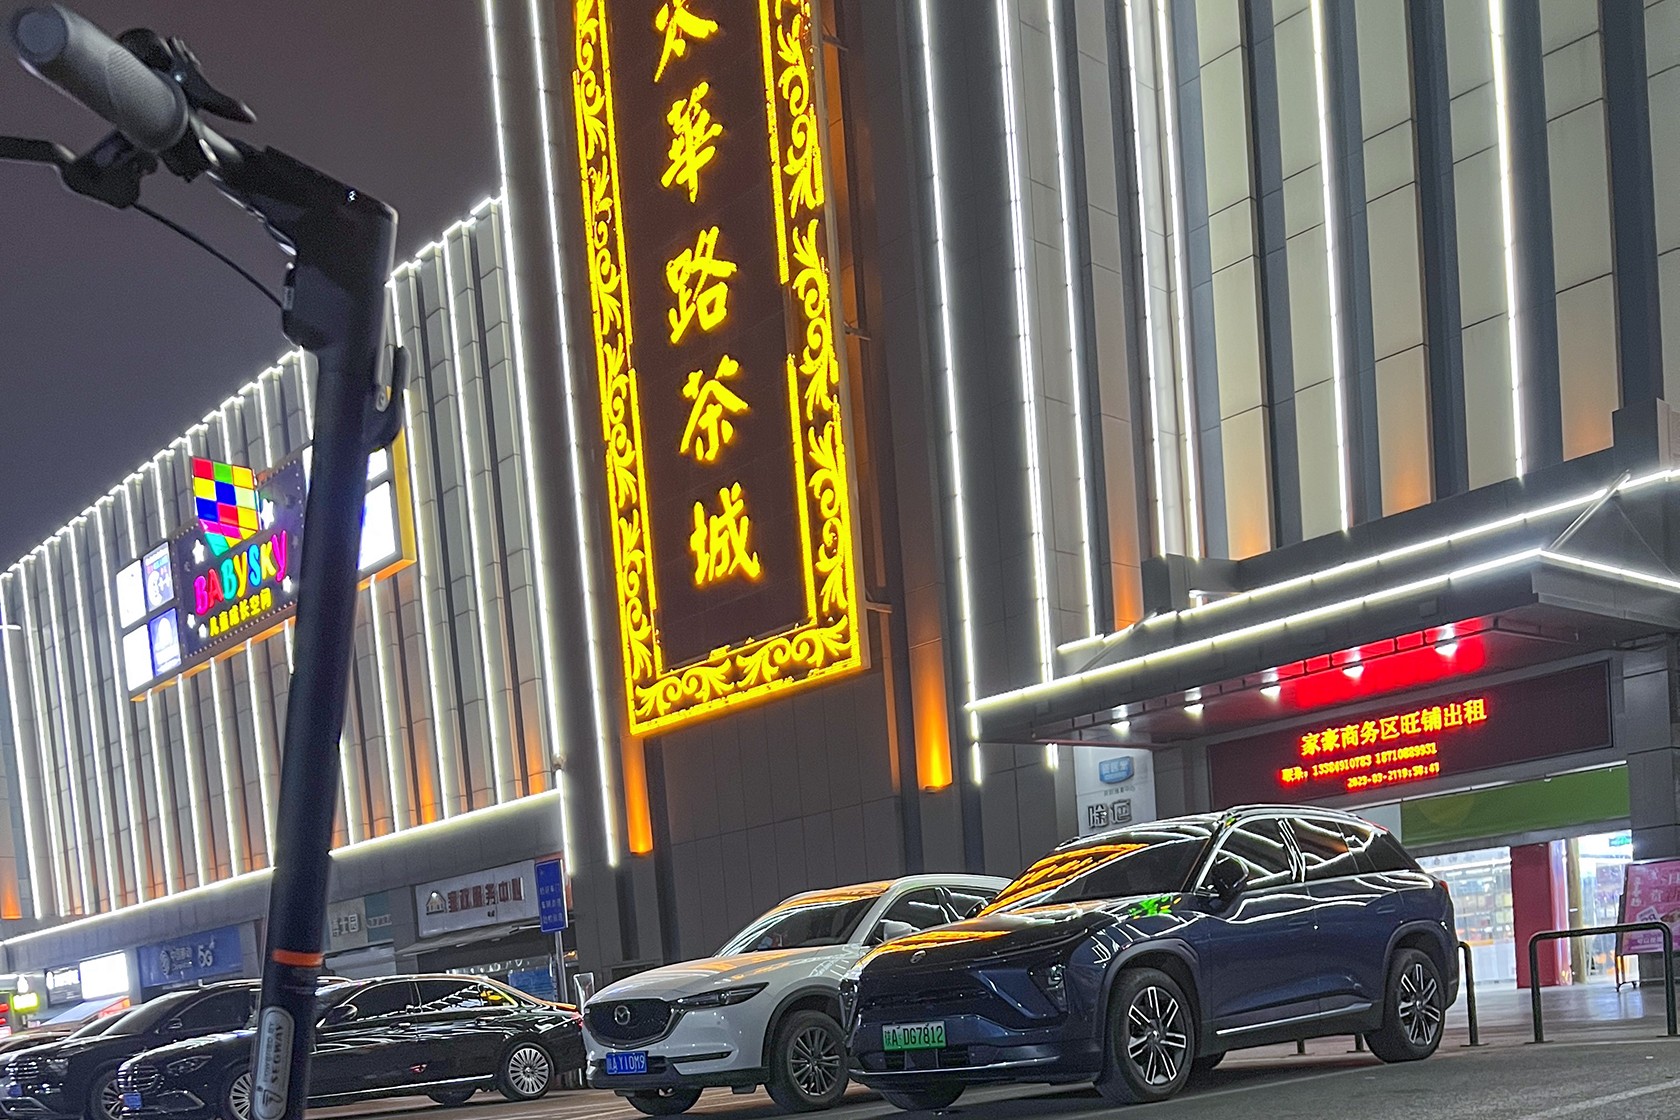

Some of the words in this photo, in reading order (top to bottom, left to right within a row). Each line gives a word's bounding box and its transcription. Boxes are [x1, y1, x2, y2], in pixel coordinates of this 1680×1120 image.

[193, 530, 288, 615] BABYSKY
[1301, 698, 1487, 756] 家豪商务区旺铺出租
[271, 1024, 283, 1084] SEGWAY
